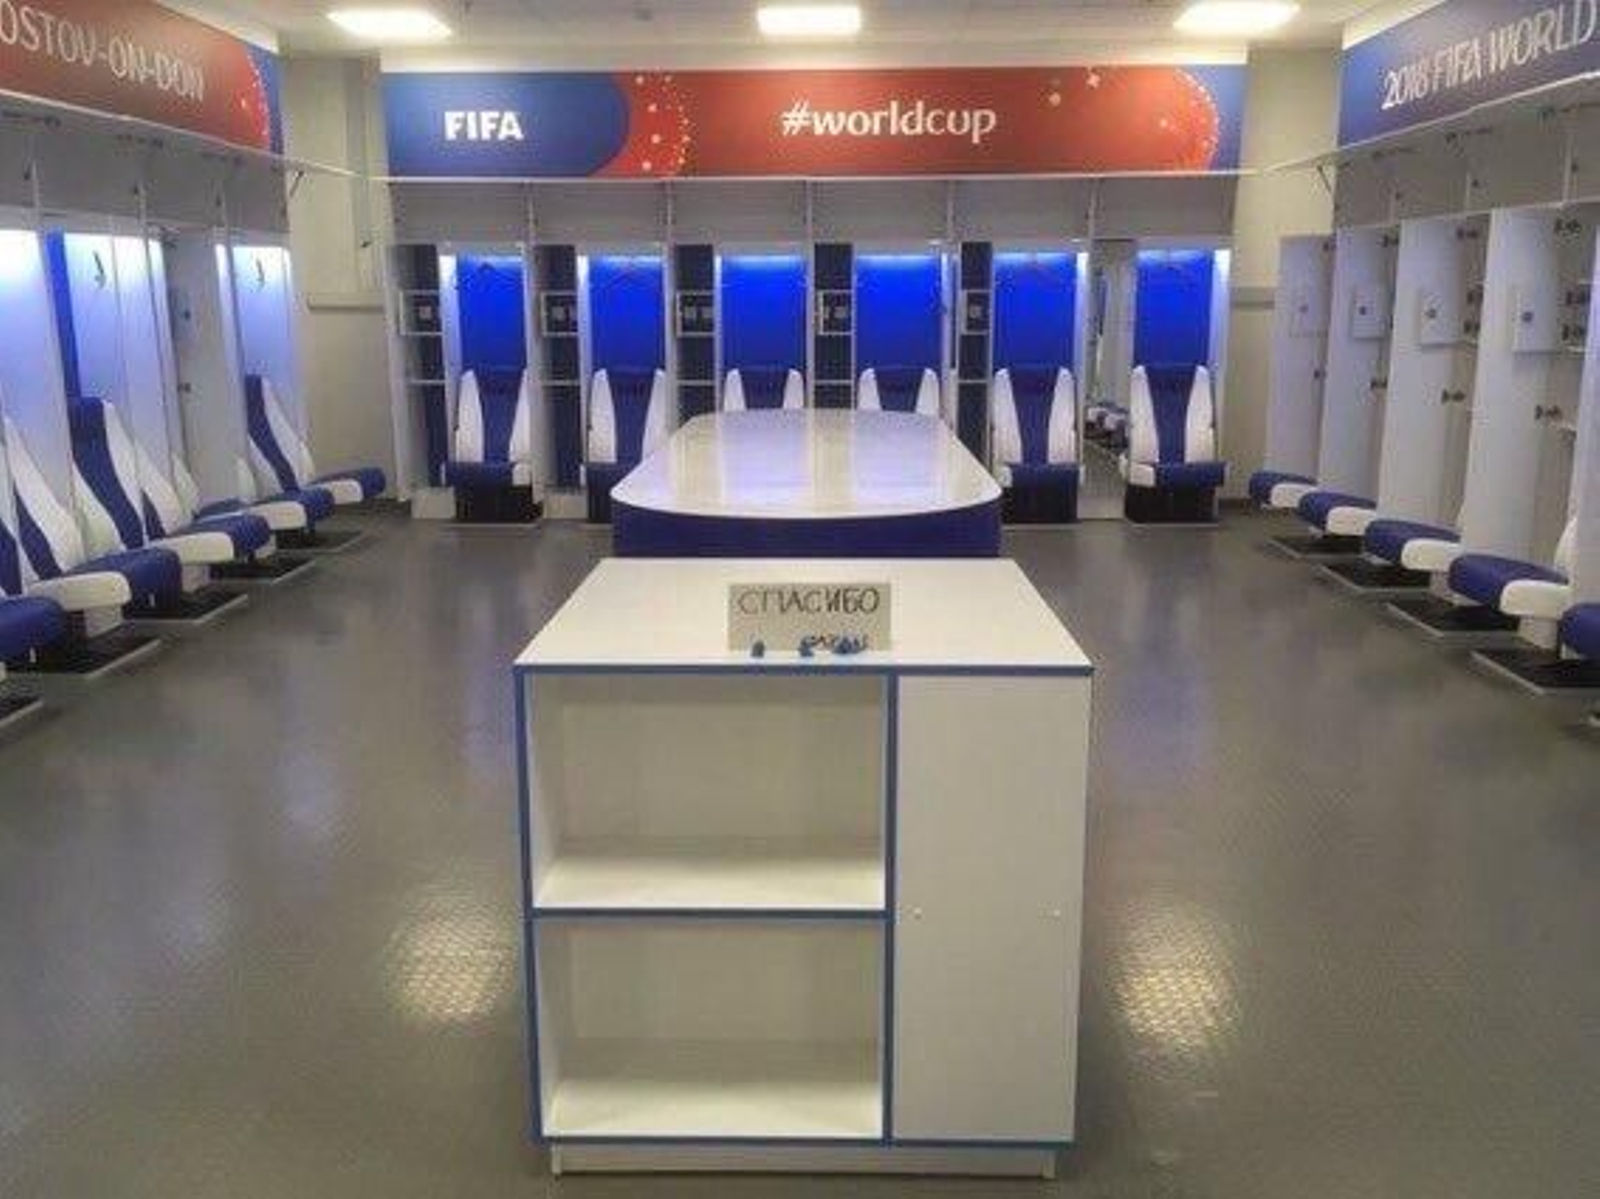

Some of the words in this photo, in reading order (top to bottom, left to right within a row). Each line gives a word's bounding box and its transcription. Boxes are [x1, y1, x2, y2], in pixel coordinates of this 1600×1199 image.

[1381, 56, 1429, 110] 2018
[1432, 38, 1482, 93] FIFA
[1489, 0, 1597, 73] WORLD
[443, 110, 525, 141] FIFA
[780, 98, 997, 142] #worldcup
[738, 587, 880, 615] СПАСИБО
